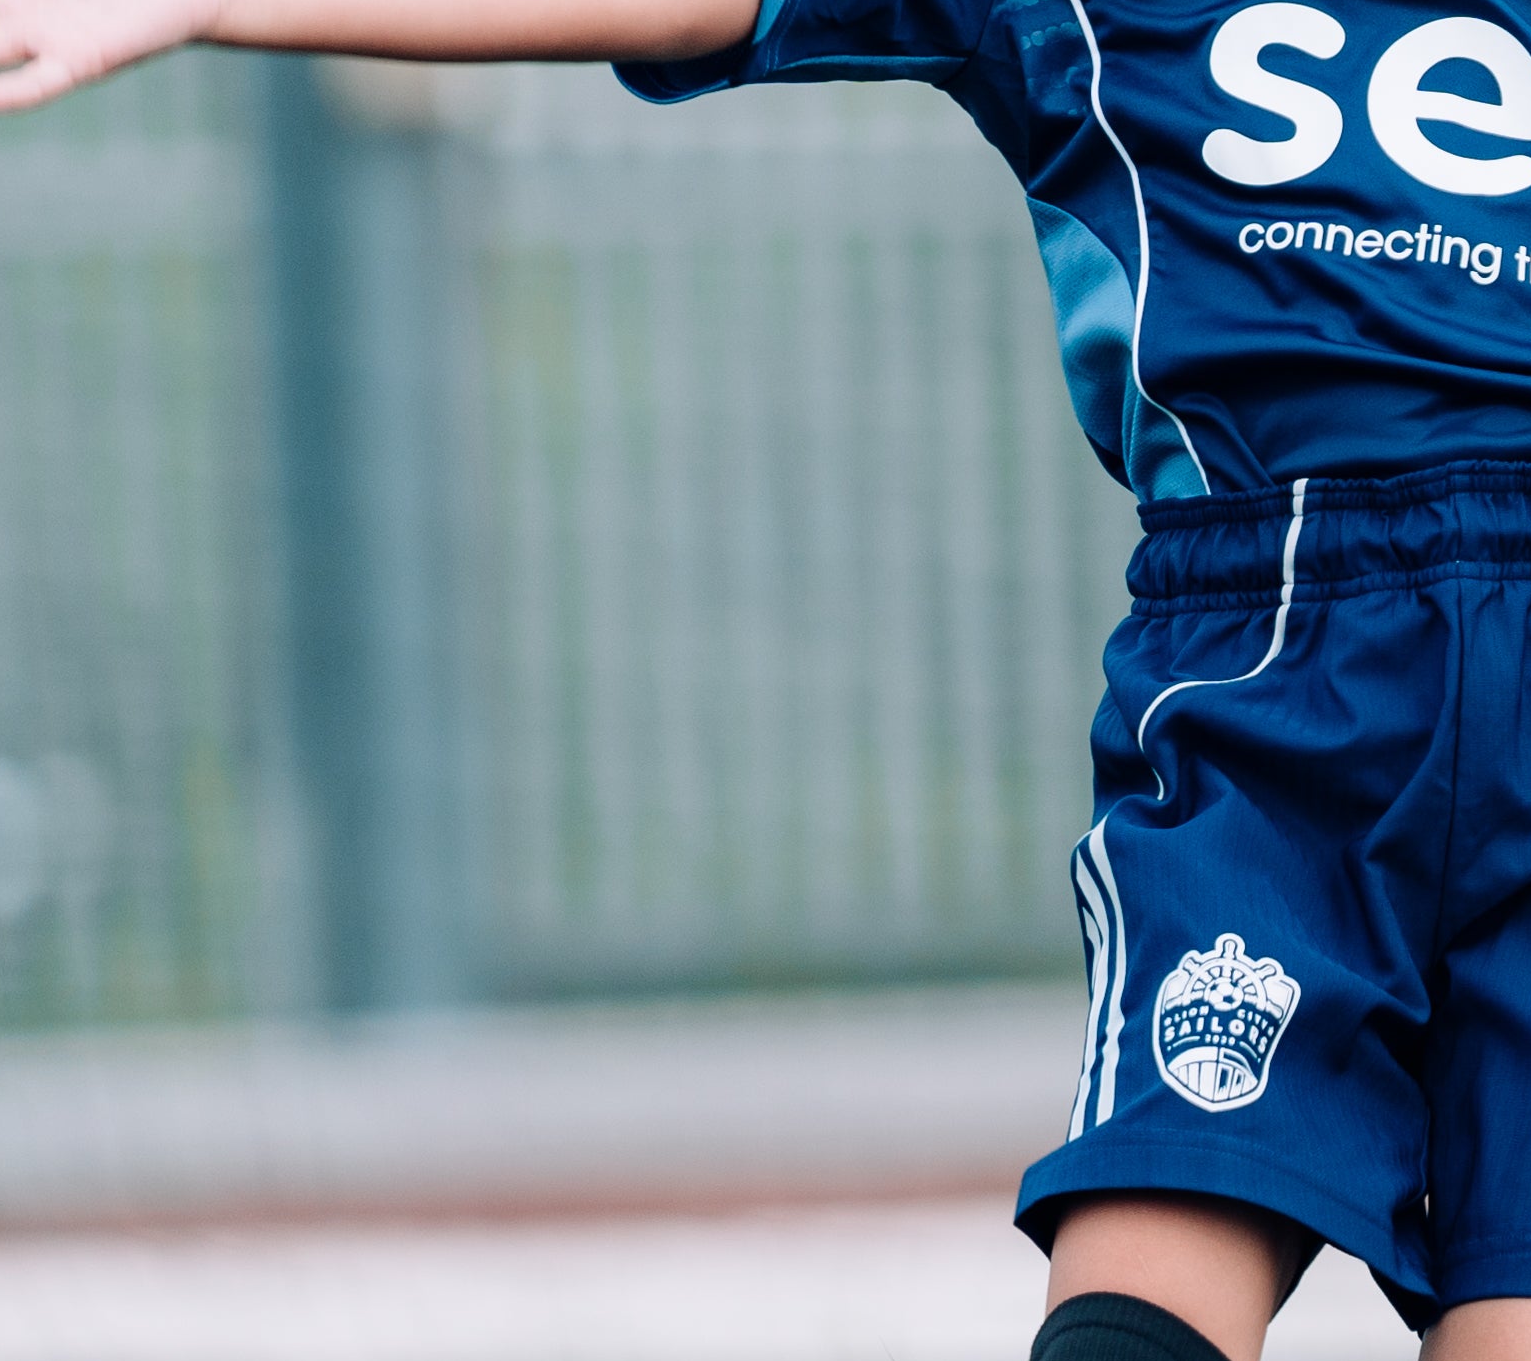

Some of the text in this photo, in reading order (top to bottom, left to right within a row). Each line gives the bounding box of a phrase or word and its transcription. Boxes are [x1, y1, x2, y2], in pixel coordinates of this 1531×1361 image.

[1238, 221, 1503, 286] connecting
[1164, 1016, 1268, 1054] SAILORS
[1174, 1005, 1268, 1030] LION CITY
